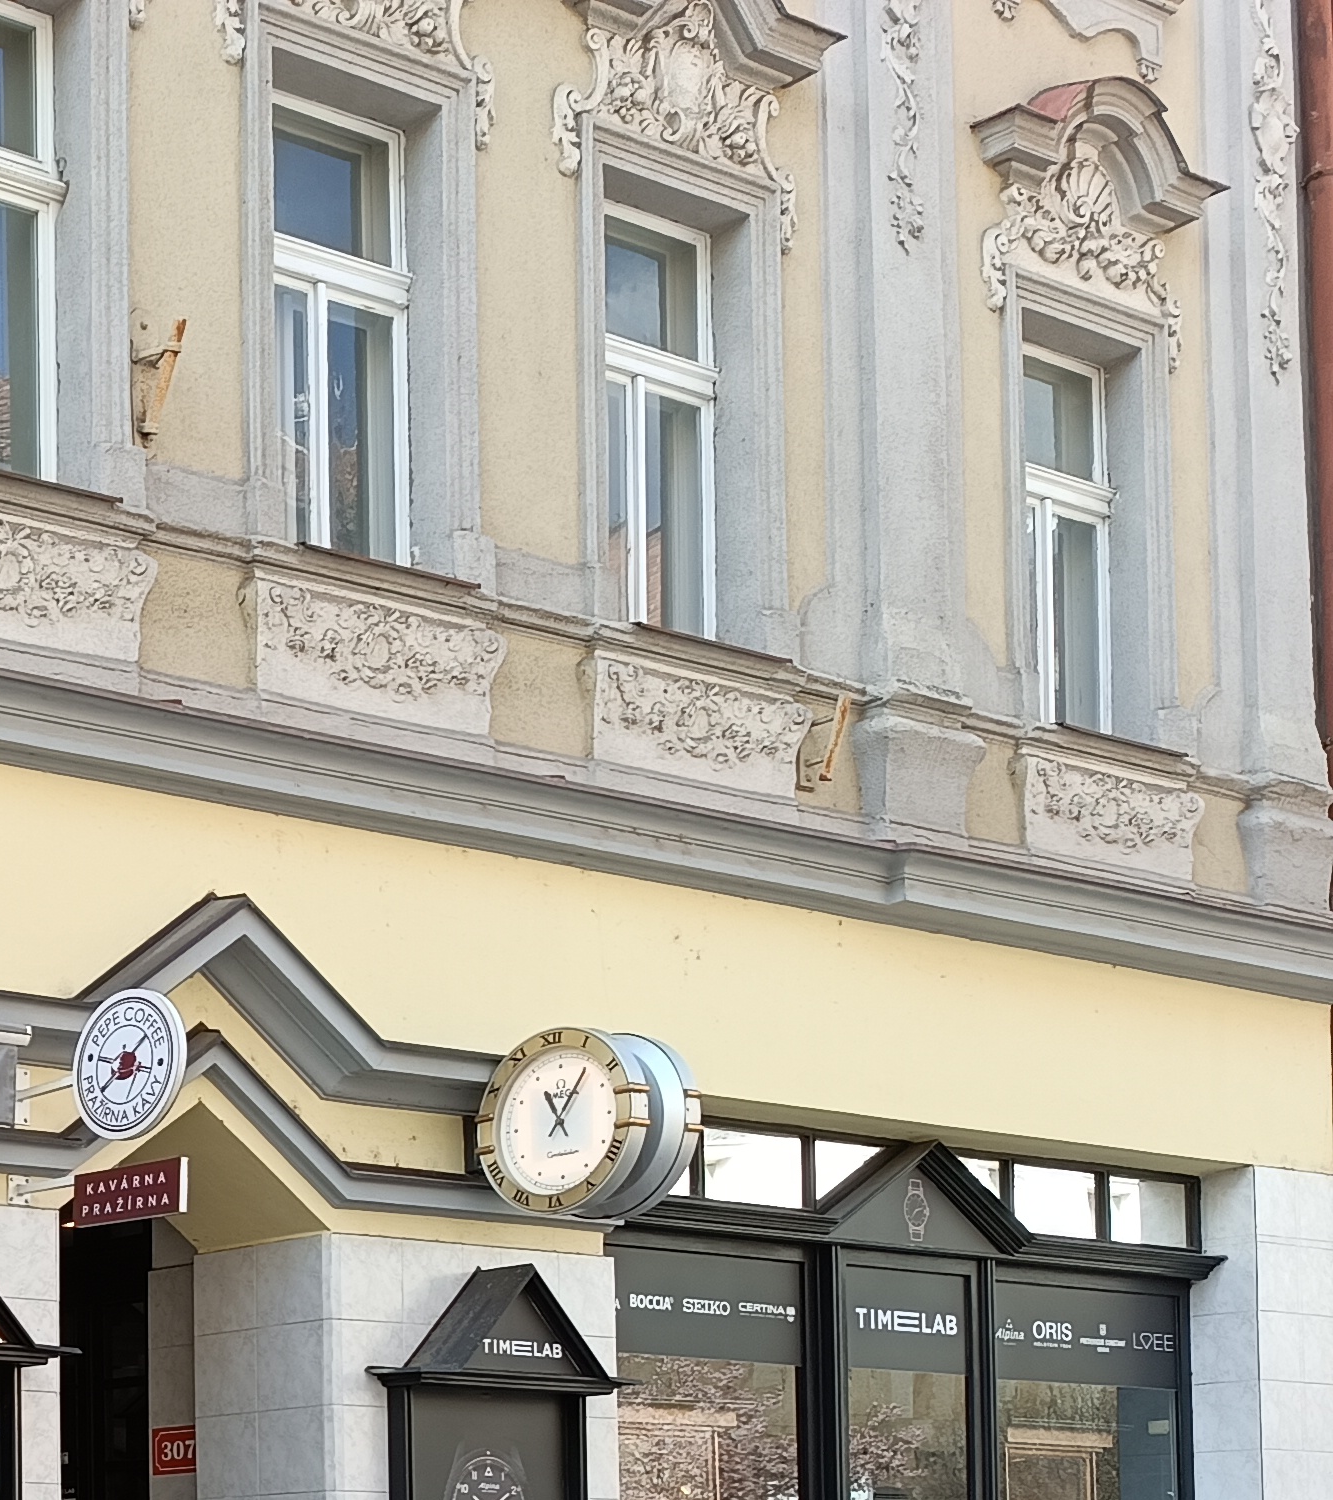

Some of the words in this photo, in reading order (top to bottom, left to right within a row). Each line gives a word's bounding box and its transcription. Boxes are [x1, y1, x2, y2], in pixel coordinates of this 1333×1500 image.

[91, 1010, 121, 1048] PEPE
[123, 1006, 166, 1049] COFFEE
[82, 1075, 131, 1124] PRAŽÍRNA
[132, 1074, 163, 1118] KÁVY
[544, 1088, 580, 1100] MEG
[86, 1171, 167, 1196] KAVÁRNA
[82, 1192, 170, 1218] PRAŽÍRNA
[682, 1298, 731, 1316] SEIKO
[738, 1302, 786, 1315] CERTINA
[855, 1307, 958, 1336] TIMELAB
[1032, 1320, 1073, 1342] ORIS
[482, 1338, 563, 1359] TIMELAB
[161, 1439, 196, 1461] 307
